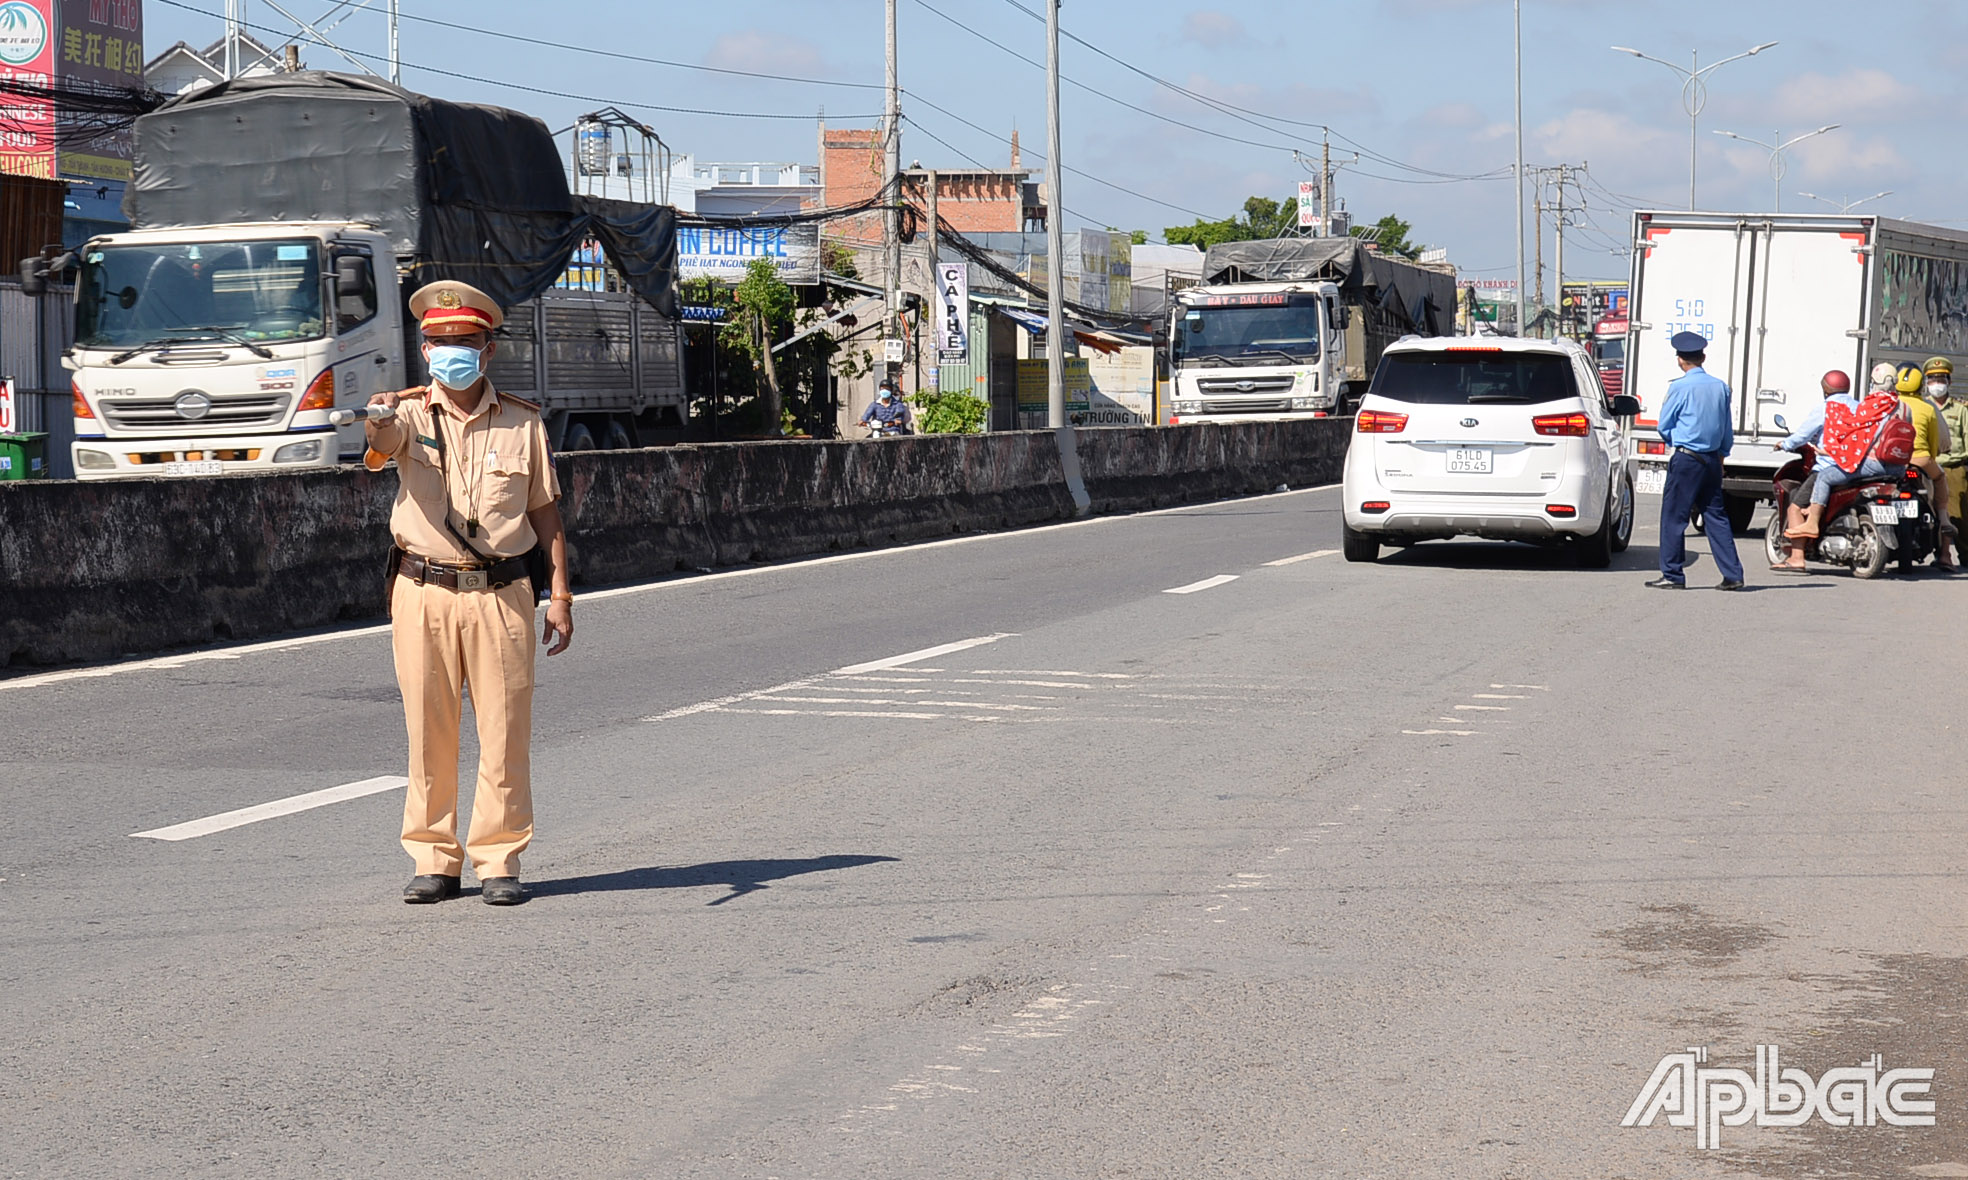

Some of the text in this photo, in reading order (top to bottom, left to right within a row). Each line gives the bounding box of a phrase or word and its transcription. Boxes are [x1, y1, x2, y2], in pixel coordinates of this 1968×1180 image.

[64, 27, 142, 75] 美托相约
[709, 228, 788, 257] COFFEE
[95, 388, 136, 396] HINO
[1462, 418, 1477, 427] KIA
[1451, 461, 1487, 471] 075.45
